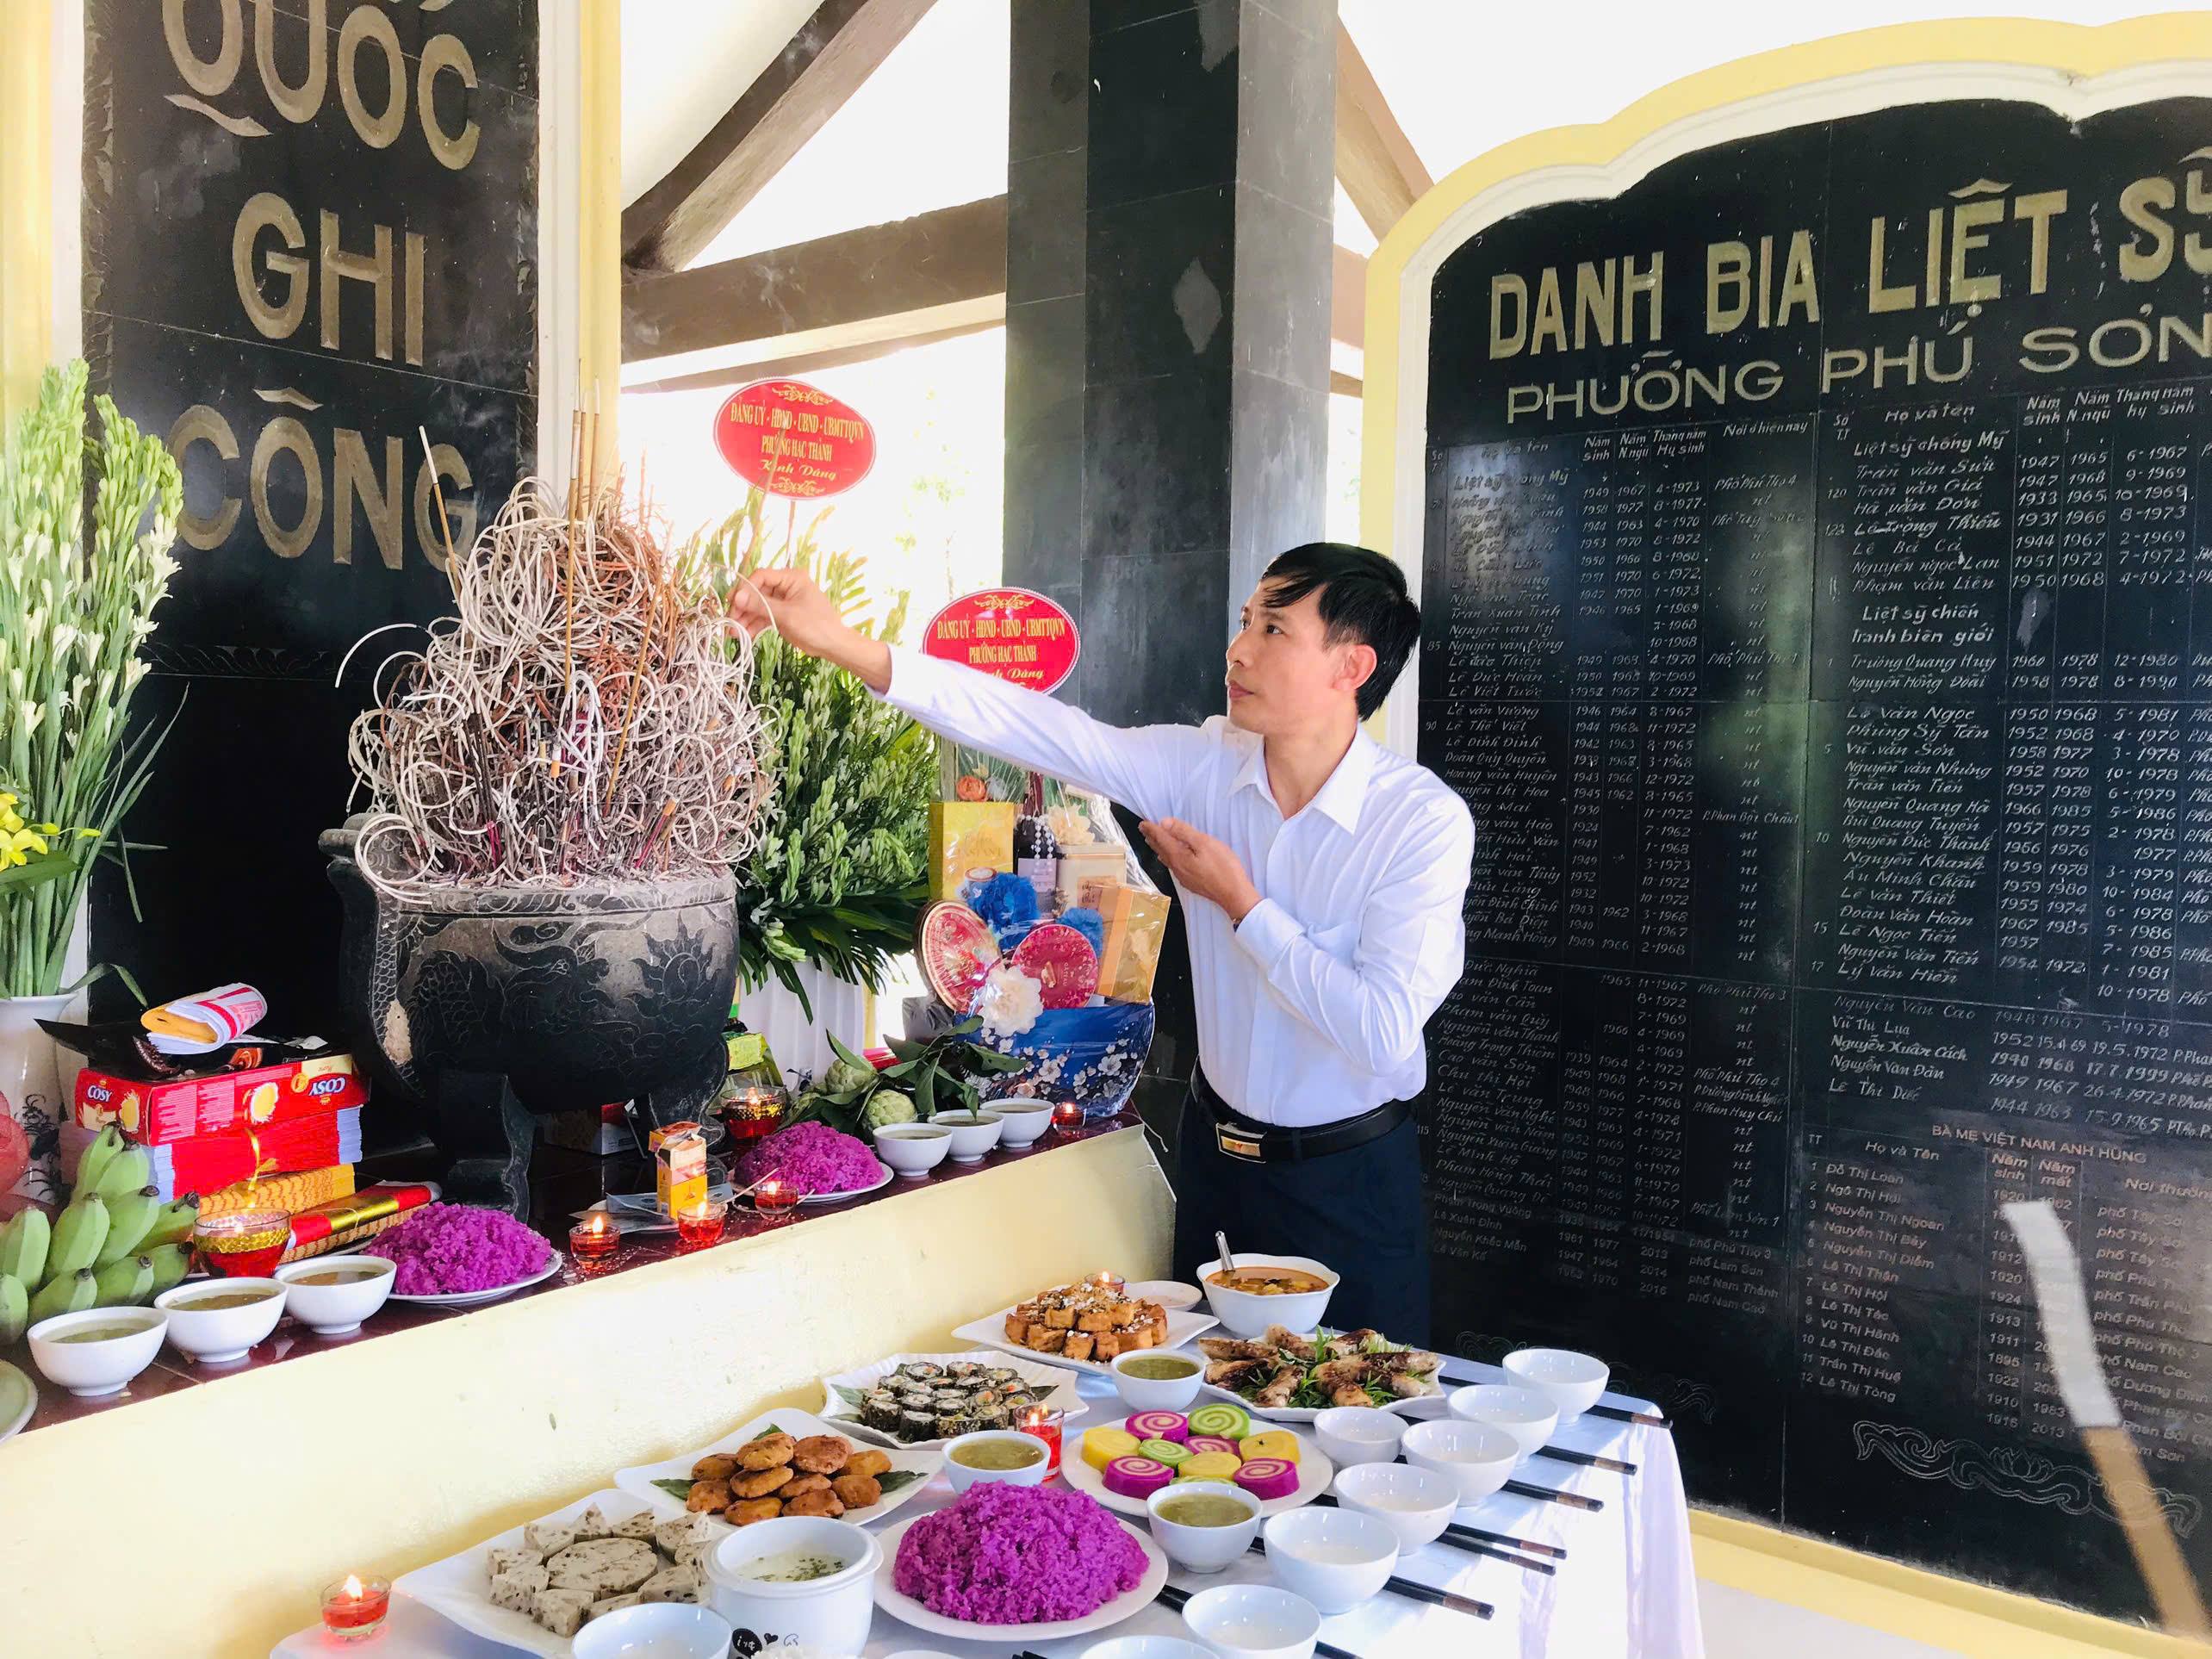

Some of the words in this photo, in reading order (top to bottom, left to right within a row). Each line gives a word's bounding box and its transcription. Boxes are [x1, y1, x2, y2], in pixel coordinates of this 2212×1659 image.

[1489, 251, 1664, 359] DANH
[1706, 229, 1819, 334] BIA
[1868, 178, 2068, 318] LIỆT
[233, 192, 426, 366] GHI
[2022, 455, 2060, 469] 1947
[171, 387, 477, 572] CÔNG
[2019, 474, 2059, 488] 1947
[1615, 502, 1644, 514] 1977
[2017, 512, 2059, 527] 1931
[2066, 511, 2105, 525] 1966
[2016, 534, 2054, 549] 1944
[2063, 532, 2105, 548] 1967
[2015, 555, 2054, 568] 1951
[2062, 551, 2103, 567] 1972
[2013, 574, 2056, 588] 1950
[2062, 571, 2104, 587] 1968
[1862, 604, 1899, 624] Liệt
[2062, 653, 2099, 668] 1978
[2060, 675, 2099, 688] 1978
[2010, 708, 2049, 721] 1950
[2054, 707, 2097, 721] 1968
[2008, 726, 2048, 740] 1952
[2055, 727, 2095, 742] 1968
[2009, 746, 2047, 759] 1958
[2054, 746, 2093, 760] 1977
[2005, 765, 2045, 777] 1952
[2053, 766, 2090, 779] 1970
[1607, 789, 1634, 800] 1962
[2006, 782, 2045, 796] 1957
[2052, 785, 2092, 798] 1978
[2004, 802, 2041, 817] 1966
[2005, 822, 2046, 836] 1957
[2052, 823, 2091, 837] 1975
[2050, 842, 2089, 857] 1976
[2134, 847, 2177, 861] 1977
[2003, 860, 2042, 874] 1959
[2049, 862, 2089, 876] 1978
[2003, 879, 2041, 893] 1959
[2000, 897, 2040, 911] 1955
[2047, 900, 2087, 915] 1974
[1999, 916, 2039, 930] 1967
[2047, 920, 2089, 935] 1985
[2000, 935, 2040, 949] 1957
[1999, 955, 2038, 970] 1954
[87, 1084, 114, 1103] COSY
[308, 1077, 346, 1097] COSY
[2035, 1078, 2080, 1094] 1967
[1808, 1134, 1823, 1145] TT
[1865, 1141, 1886, 1155] Họ
[2021, 1137, 2055, 1152] NAM
[2060, 1143, 2095, 1156] ANH
[2031, 1422, 2066, 1438] 2013
